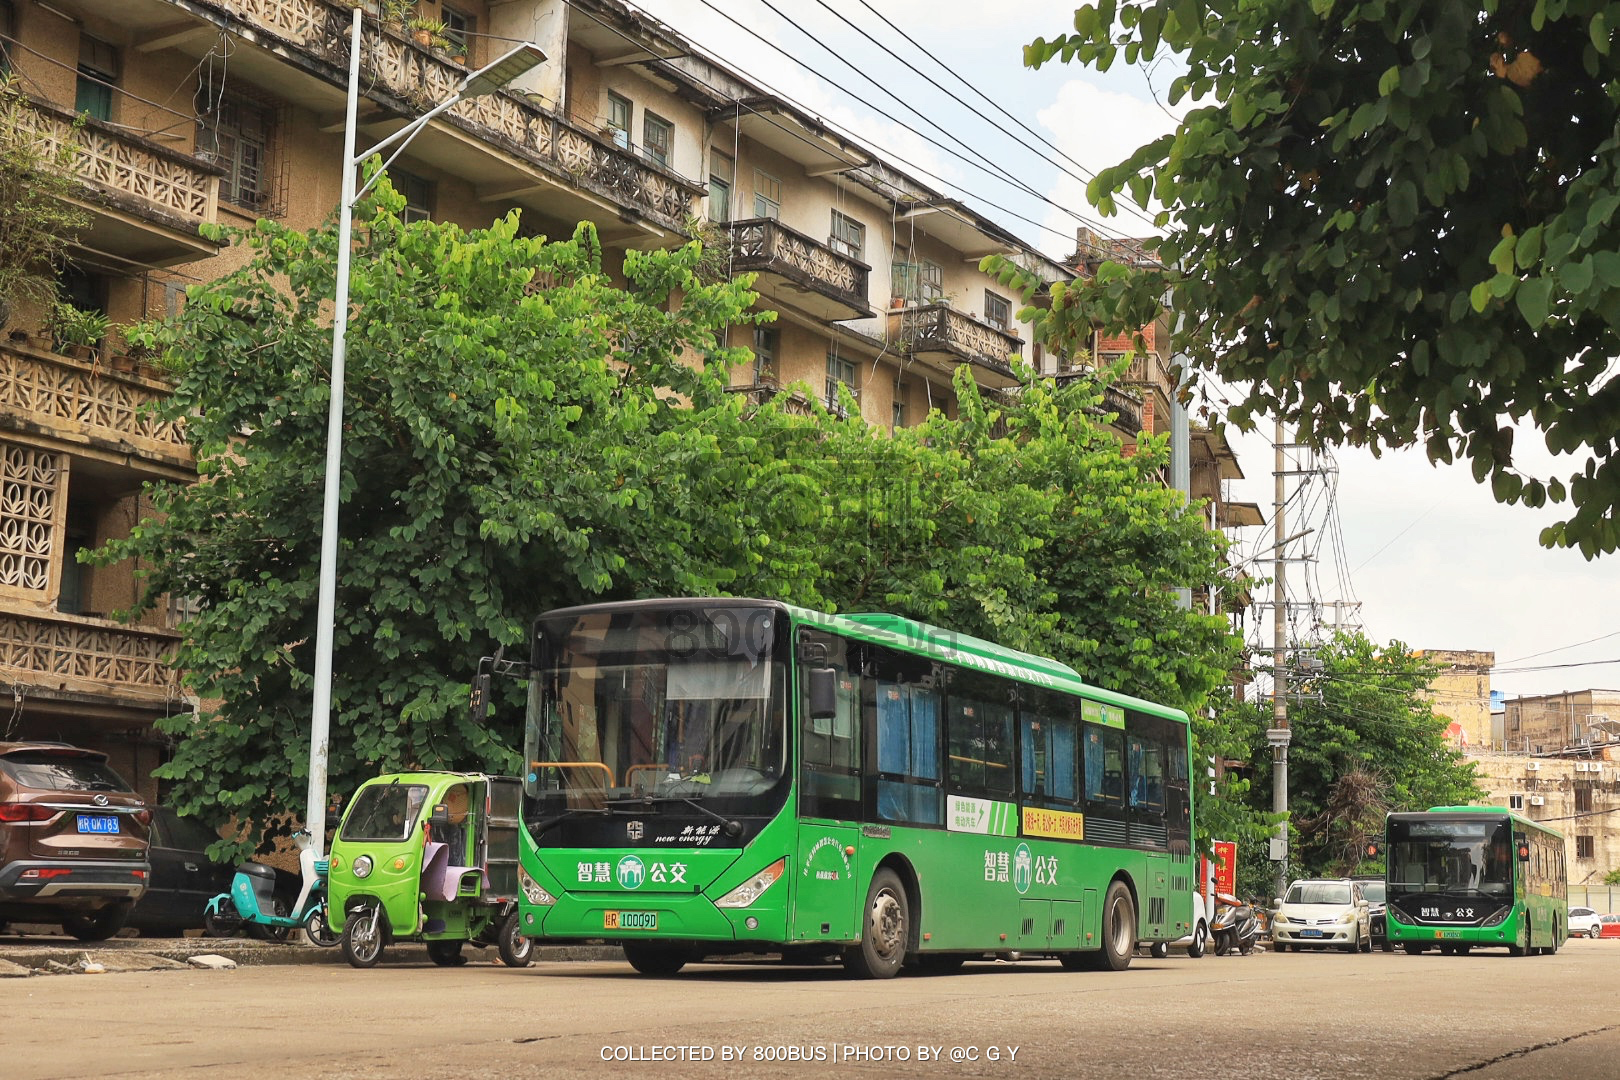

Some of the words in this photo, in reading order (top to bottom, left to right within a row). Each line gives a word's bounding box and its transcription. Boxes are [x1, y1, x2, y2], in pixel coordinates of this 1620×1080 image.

[955, 816, 976, 828] 电动汽车
[681, 825, 721, 835] 新能源
[655, 835, 677, 843] new
[678, 835, 714, 845] energy
[577, 861, 611, 883] 智慧
[650, 862, 688, 884] 公交
[984, 849, 1010, 883] 智慧
[1034, 855, 1059, 885] 公交
[1420, 907, 1440, 917] 智慧
[1455, 907, 1475, 917] 公交
